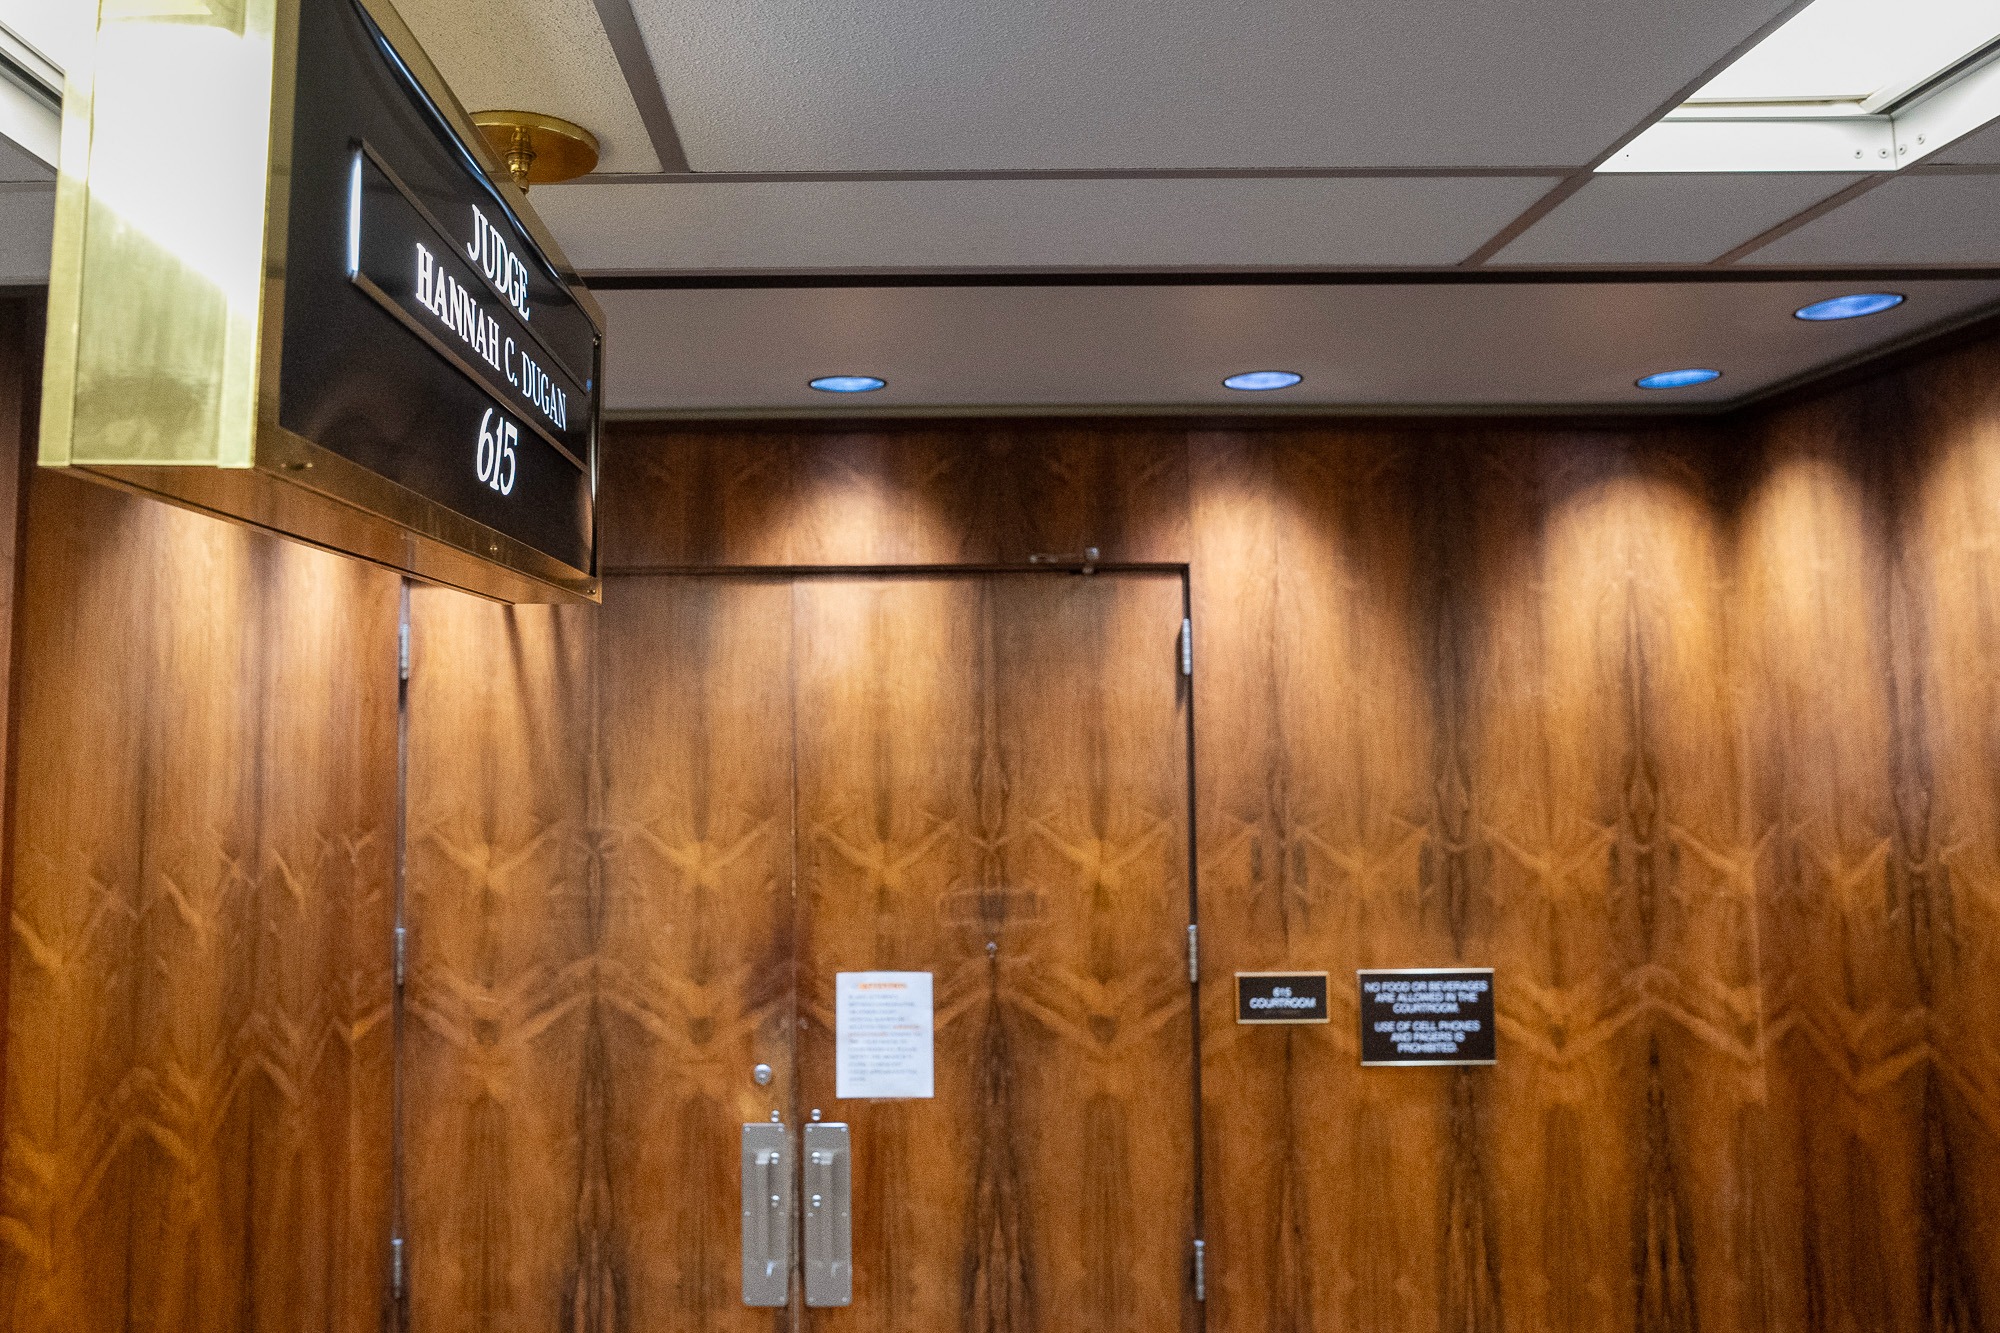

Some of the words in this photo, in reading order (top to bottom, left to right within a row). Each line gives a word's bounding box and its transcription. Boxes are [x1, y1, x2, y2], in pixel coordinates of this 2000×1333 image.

[467, 204, 530, 321] JUDGE
[416, 243, 500, 371] HANNAH
[504, 337, 518, 386] C.
[521, 351, 567, 431] DUGAN
[476, 407, 518, 496] 615
[1364, 981, 1380, 992] NO
[1381, 981, 1410, 992] FOOD
[1411, 981, 1427, 992] OR
[1428, 981, 1488, 992] BEVERAGES
[1249, 997, 1317, 1009] COURTROOM
[1374, 991, 1396, 1003] ARE
[1396, 991, 1444, 1002] ALLOWED
[1374, 1020, 1396, 1032] USE
[1396, 1020, 1412, 1032] OF
[1412, 1020, 1437, 1032] CELL
[1438, 1020, 1481, 1032] PHONES
